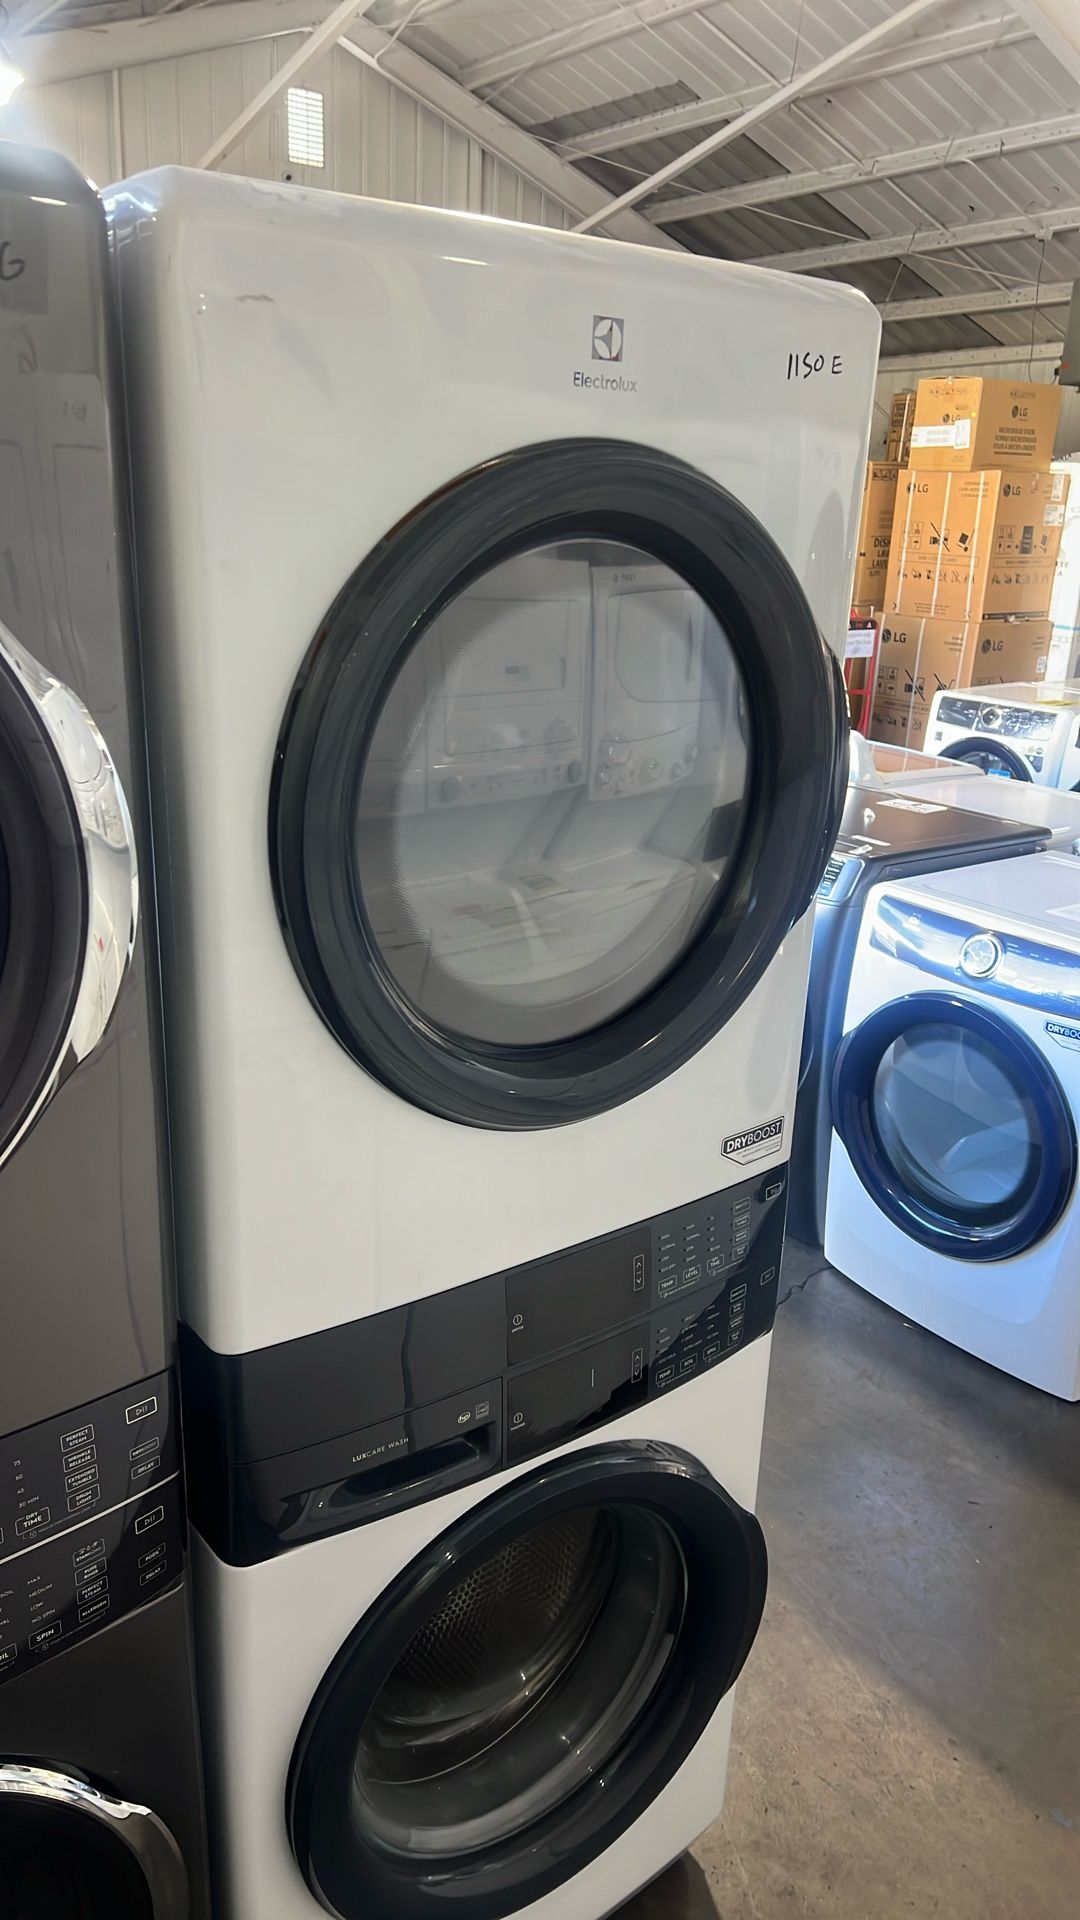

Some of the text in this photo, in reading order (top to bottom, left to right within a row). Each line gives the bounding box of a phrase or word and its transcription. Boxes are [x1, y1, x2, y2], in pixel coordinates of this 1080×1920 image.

[787, 352, 843, 380] 1150 E
[573, 371, 637, 392] Electrolux
[1019, 407, 1028, 417] LG
[917, 484, 929, 493] LG
[1011, 486, 1022, 496] LG
[893, 631, 907, 643] LG
[991, 640, 1004, 651] LG
[726, 1122, 781, 1153] DRYBOOST
[661, 1280, 674, 1289] TEMP
[65, 1429, 89, 1442] PERFECT
[69, 1435, 87, 1447] STEAM
[68, 1449, 91, 1462] WRINKLE
[352, 1436, 409, 1463] LUXCARE WASH
[68, 1454, 91, 1468] RELEASE
[138, 1461, 154, 1473] DELAY
[68, 1468, 96, 1484] EXTENDED
[72, 1475, 93, 1487] TUMBLE
[75, 1490, 92, 1501] DRUM
[23, 1515, 42, 1528] TIME
[25, 1511, 39, 1520] DRY
[27, 1576, 41, 1586] MAX
[28, 1583, 53, 1598] MEDIUM
[81, 1580, 103, 1595] PERFECT
[30, 1601, 44, 1611] LOW
[31, 1608, 56, 1624] NO SPIN
[36, 1628, 54, 1642] SPIN
